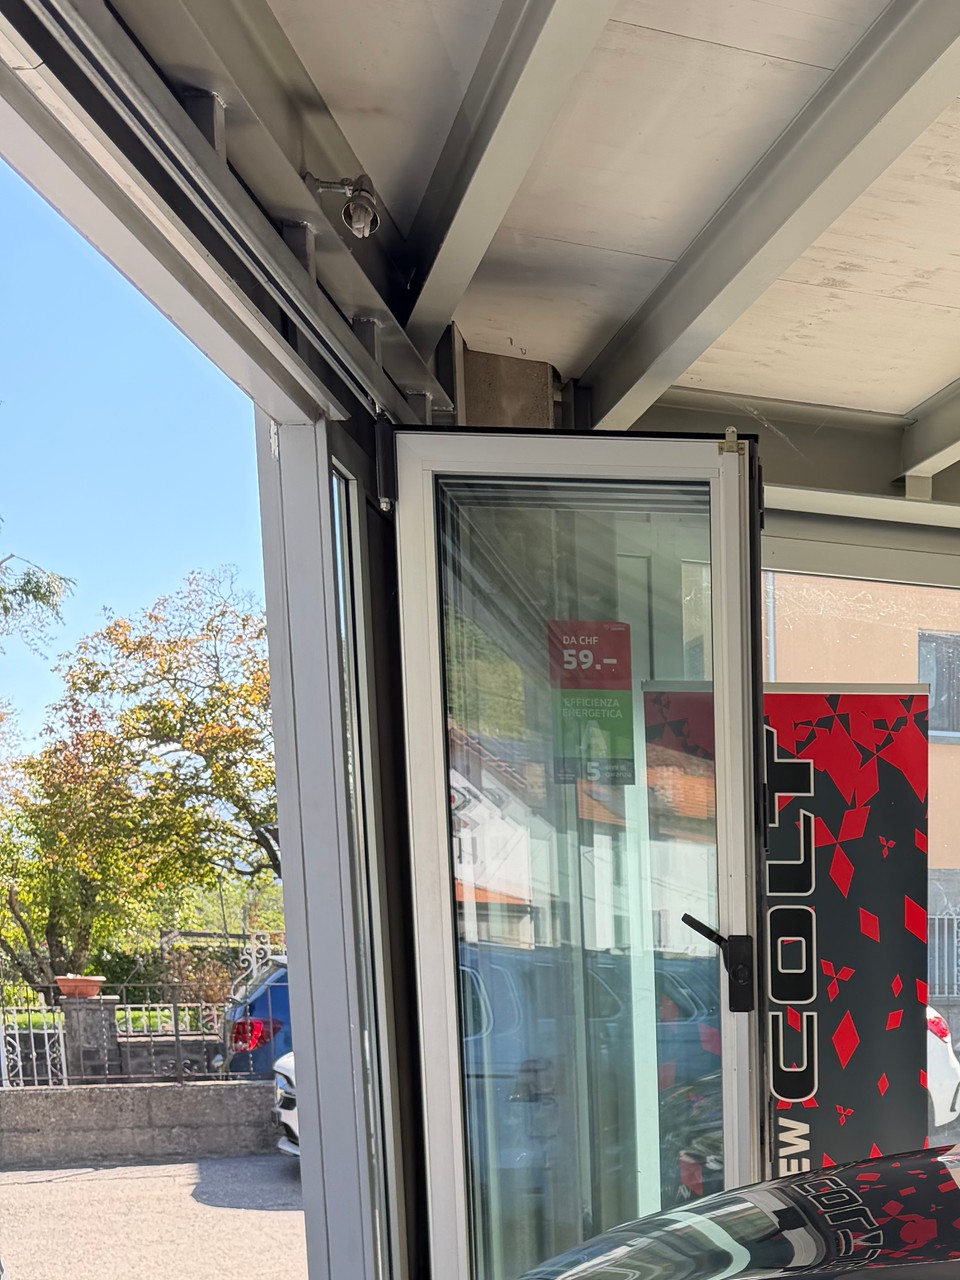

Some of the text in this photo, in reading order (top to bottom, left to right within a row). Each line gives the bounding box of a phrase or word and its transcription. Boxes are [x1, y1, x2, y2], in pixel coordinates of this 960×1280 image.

[562, 635, 599, 645] DA CHF
[563, 697, 620, 708] EFFICIENZA
[562, 708, 623, 719] ENERGETICA
[586, 761, 601, 782] 5
[763, 724, 817, 1176] EW COLT
